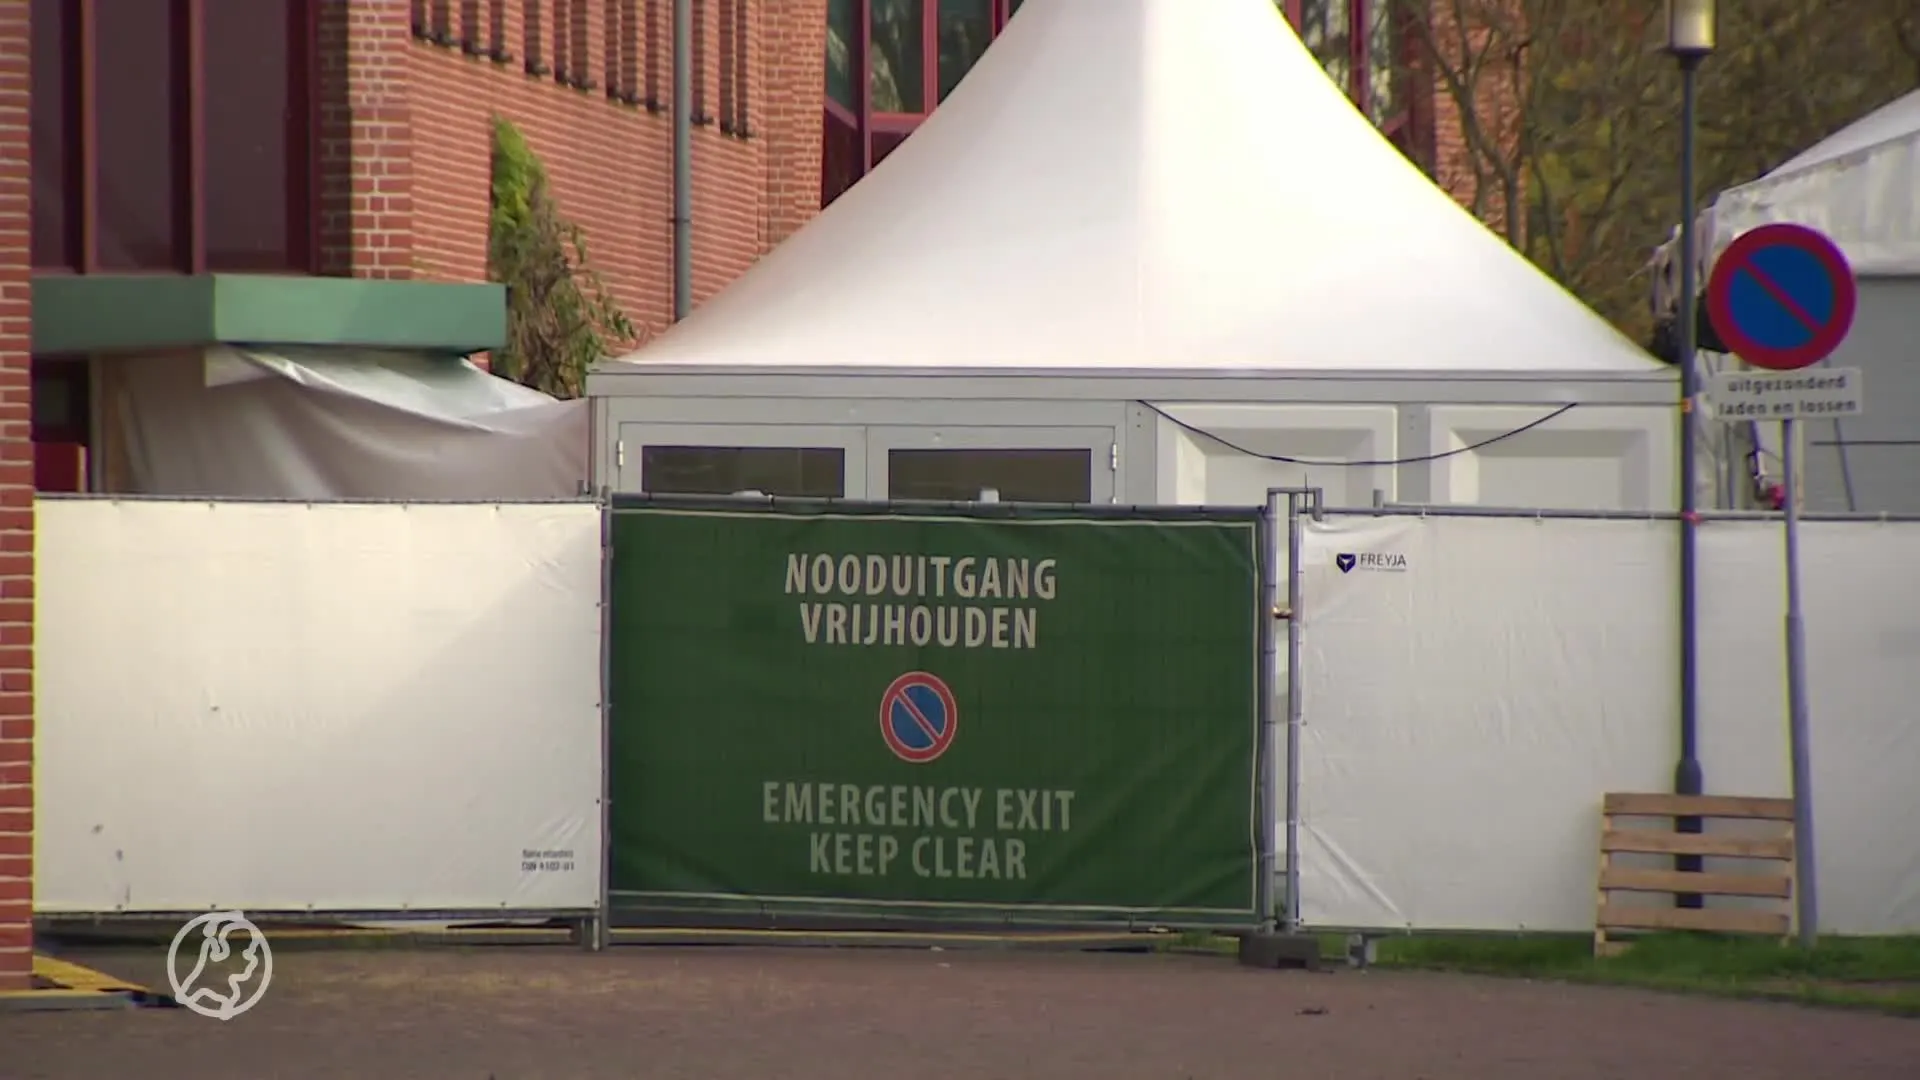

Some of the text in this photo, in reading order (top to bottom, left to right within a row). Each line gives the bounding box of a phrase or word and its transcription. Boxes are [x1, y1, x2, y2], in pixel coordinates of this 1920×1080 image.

[1719, 400, 1857, 415] laden en lossen
[1728, 376, 1846, 394] uitgezonderd
[785, 553, 1057, 599] NOODUITGANG
[1360, 553, 1407, 566] FREYJA
[800, 602, 1038, 649] VRIJHOUDEN
[763, 781, 1075, 832] EMERGENCY EXIT
[809, 832, 1028, 880] KEEP CLEAR
